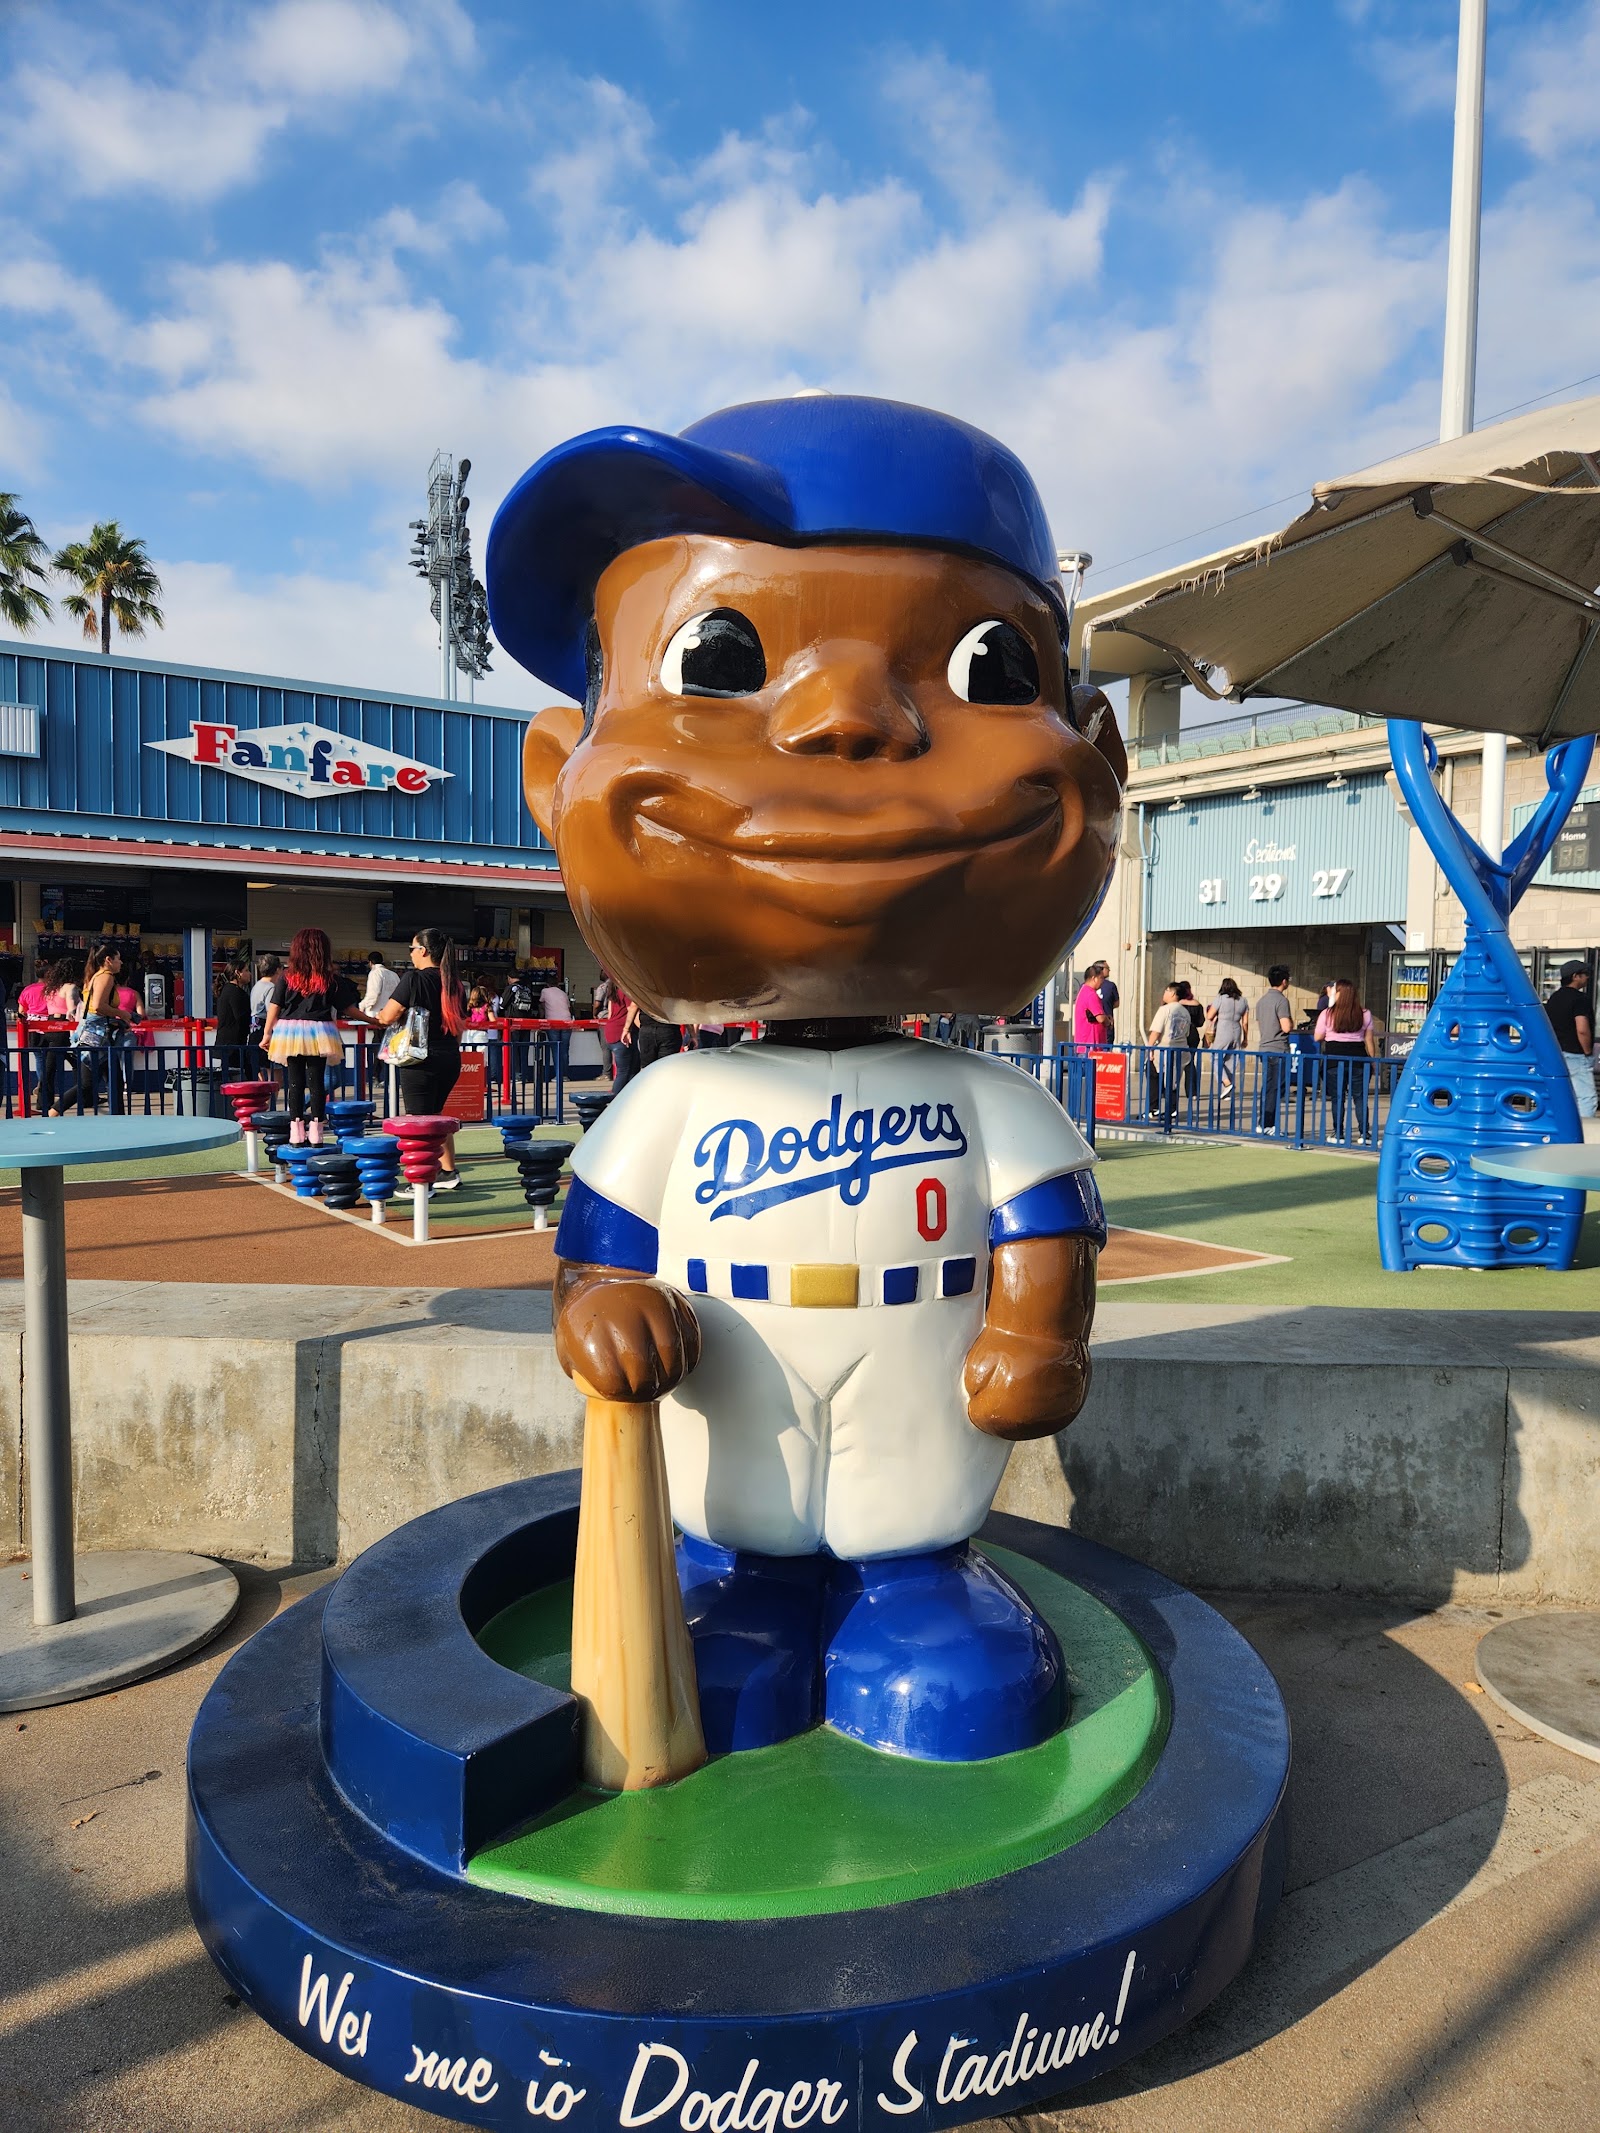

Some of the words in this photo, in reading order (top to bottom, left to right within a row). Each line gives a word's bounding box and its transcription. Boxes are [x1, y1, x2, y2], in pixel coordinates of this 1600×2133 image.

[191, 721, 430, 793] Fanfare
[1571, 804, 1584, 812] all
[1243, 838, 1296, 863] Sections
[1561, 832, 1586, 841] Home
[1199, 878, 1224, 904] 31
[1249, 873, 1284, 900] 29
[1312, 868, 1350, 897] 27
[461, 1064, 481, 1072] ZONE
[1106, 1064, 1123, 1074] ZONE
[694, 1094, 967, 1206] Dodgers
[916, 1178, 947, 1242] 0
[619, 2042, 849, 2133] Dodger
[877, 1950, 1137, 2115] Stadium!
